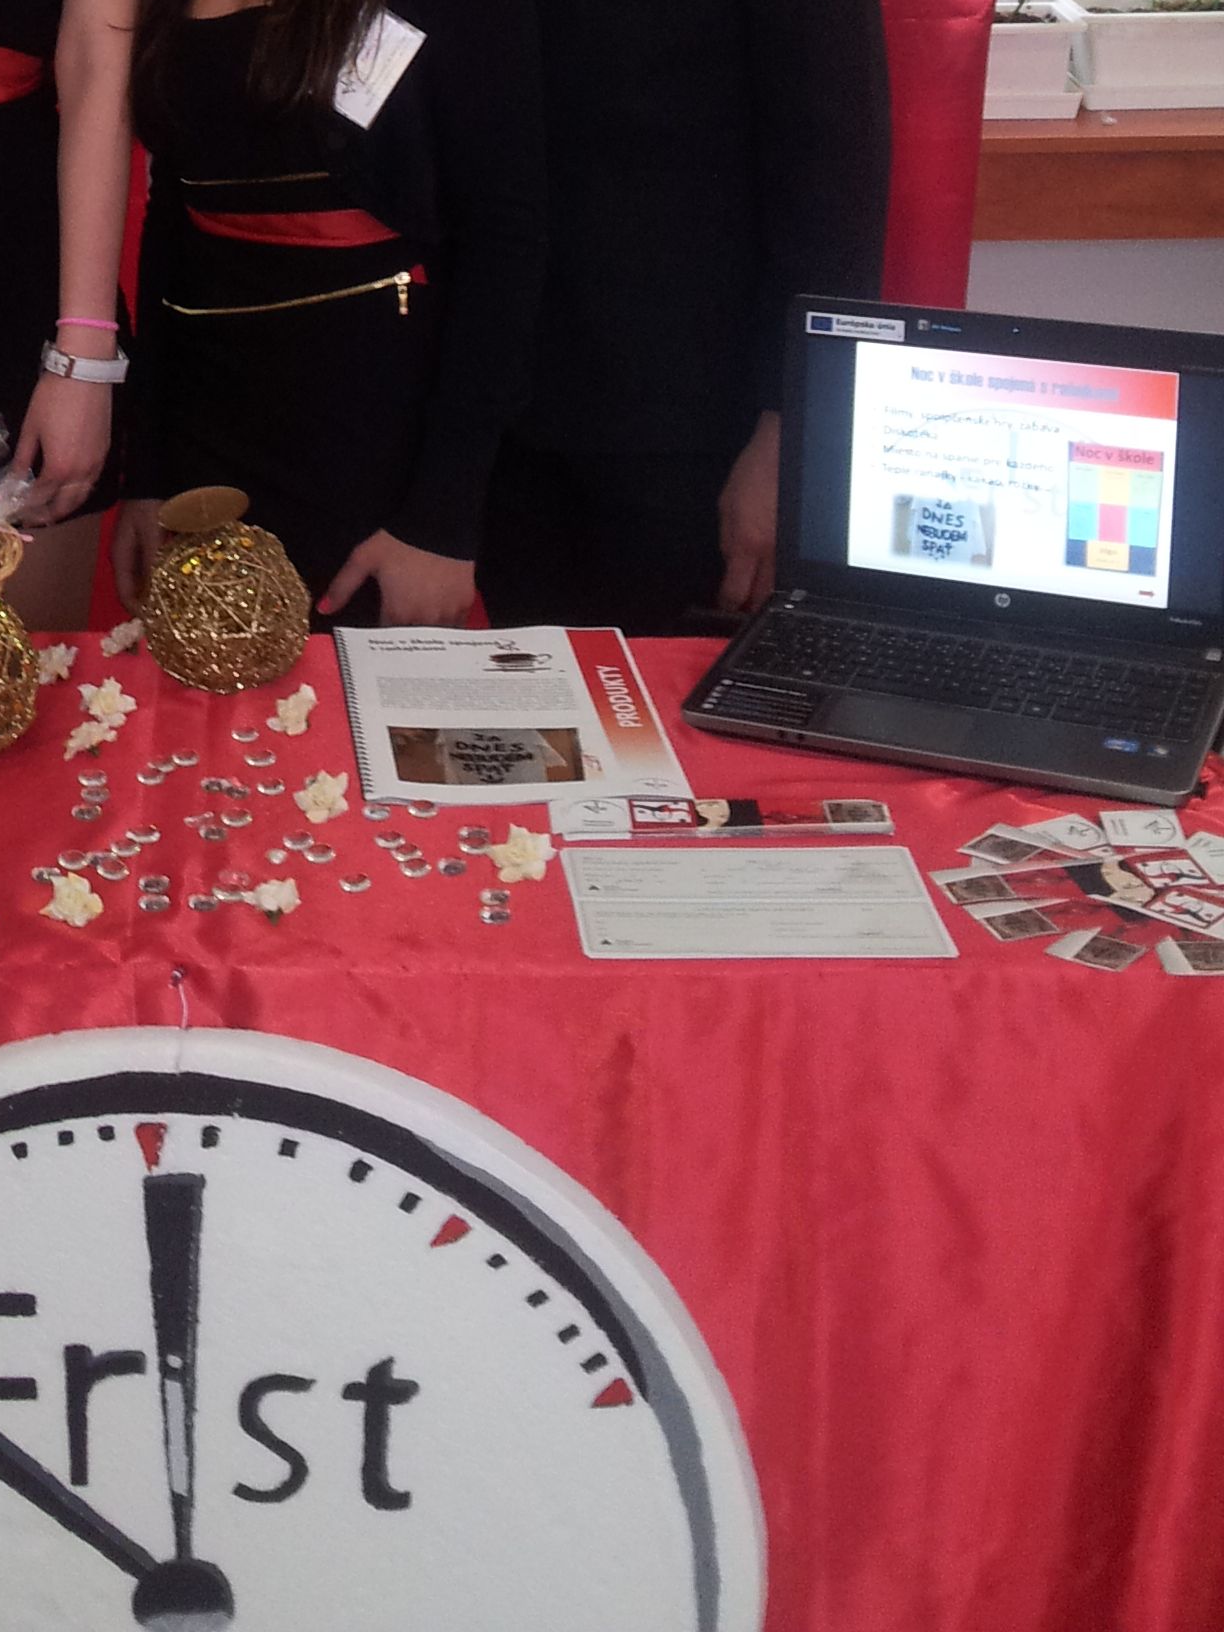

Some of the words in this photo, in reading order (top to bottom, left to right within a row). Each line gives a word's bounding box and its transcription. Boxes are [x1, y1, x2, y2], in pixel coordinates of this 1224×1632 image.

[1075, 445, 1102, 459] Noc
[1118, 449, 1155, 465] škole
[922, 506, 965, 528] DNES
[596, 665, 643, 728] PRODUKTY
